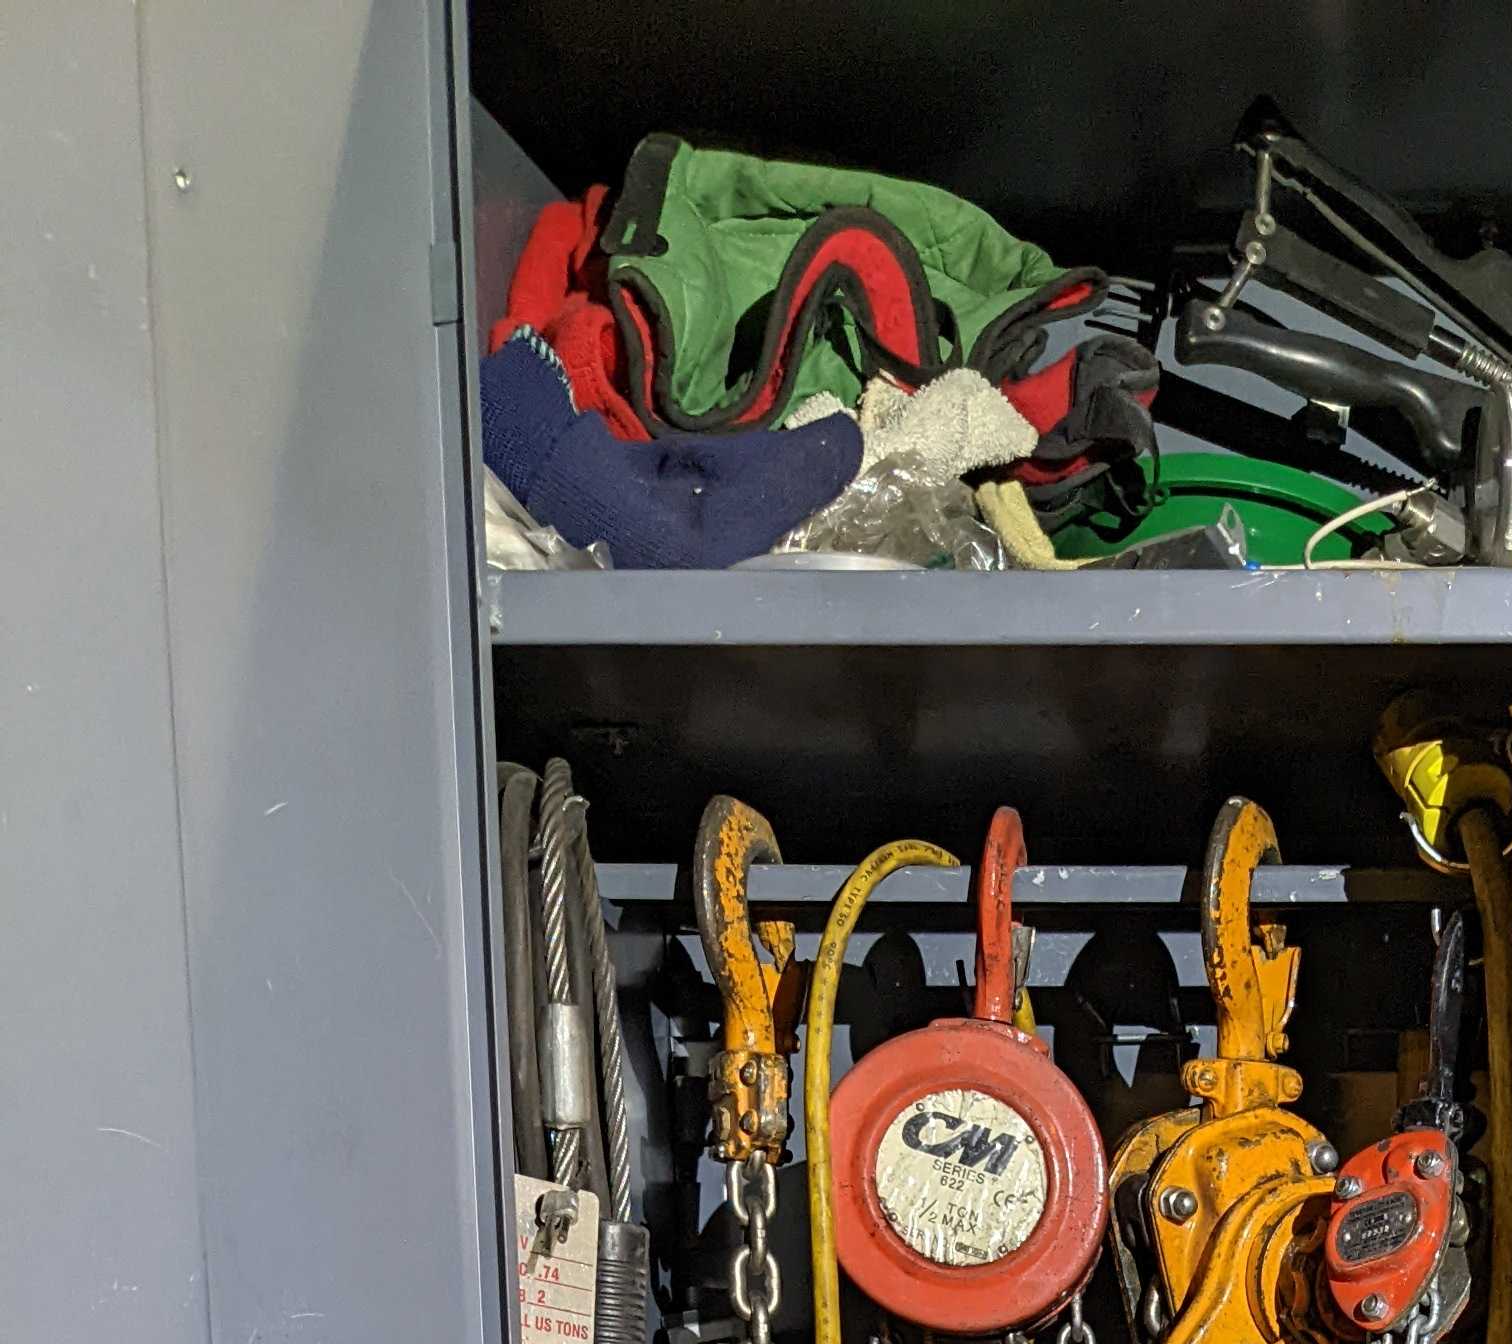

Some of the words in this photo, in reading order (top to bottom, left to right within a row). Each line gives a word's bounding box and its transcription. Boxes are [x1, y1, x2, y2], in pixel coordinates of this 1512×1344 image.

[902, 1111, 1019, 1176] CM
[932, 1158, 986, 1186] SERIES
[940, 1175, 965, 1193] 622
[942, 1213, 978, 1236] MAX
[537, 1290, 546, 1305] 2
[535, 1316, 552, 1333] US
[556, 1320, 589, 1340] TONS
